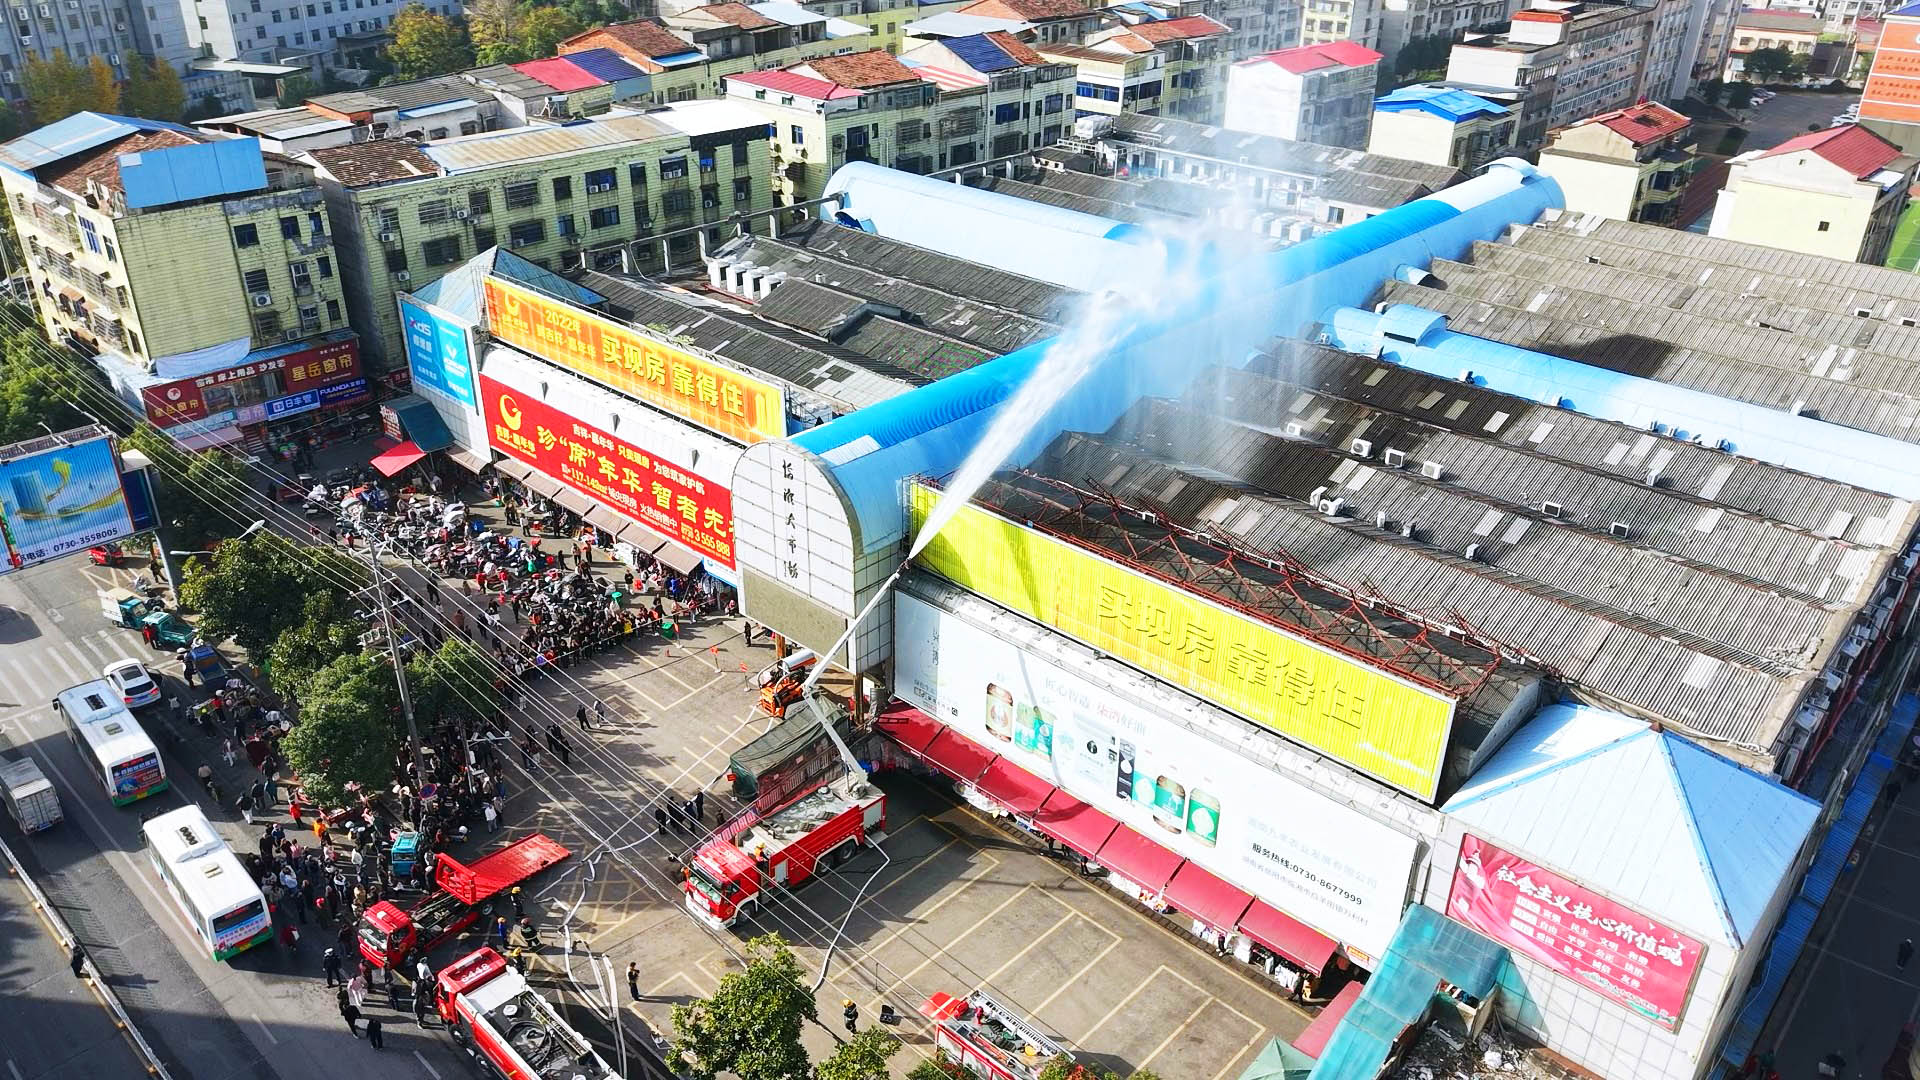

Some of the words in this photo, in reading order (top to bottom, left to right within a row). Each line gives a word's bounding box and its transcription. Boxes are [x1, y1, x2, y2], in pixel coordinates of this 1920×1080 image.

[602, 334, 667, 387] 买现房
[672, 362, 745, 418] 靠得住
[1099, 585, 1215, 664] 买现房
[1225, 643, 1366, 730] 靠得住
[1496, 864, 1684, 967] 社会主义核心价值观
